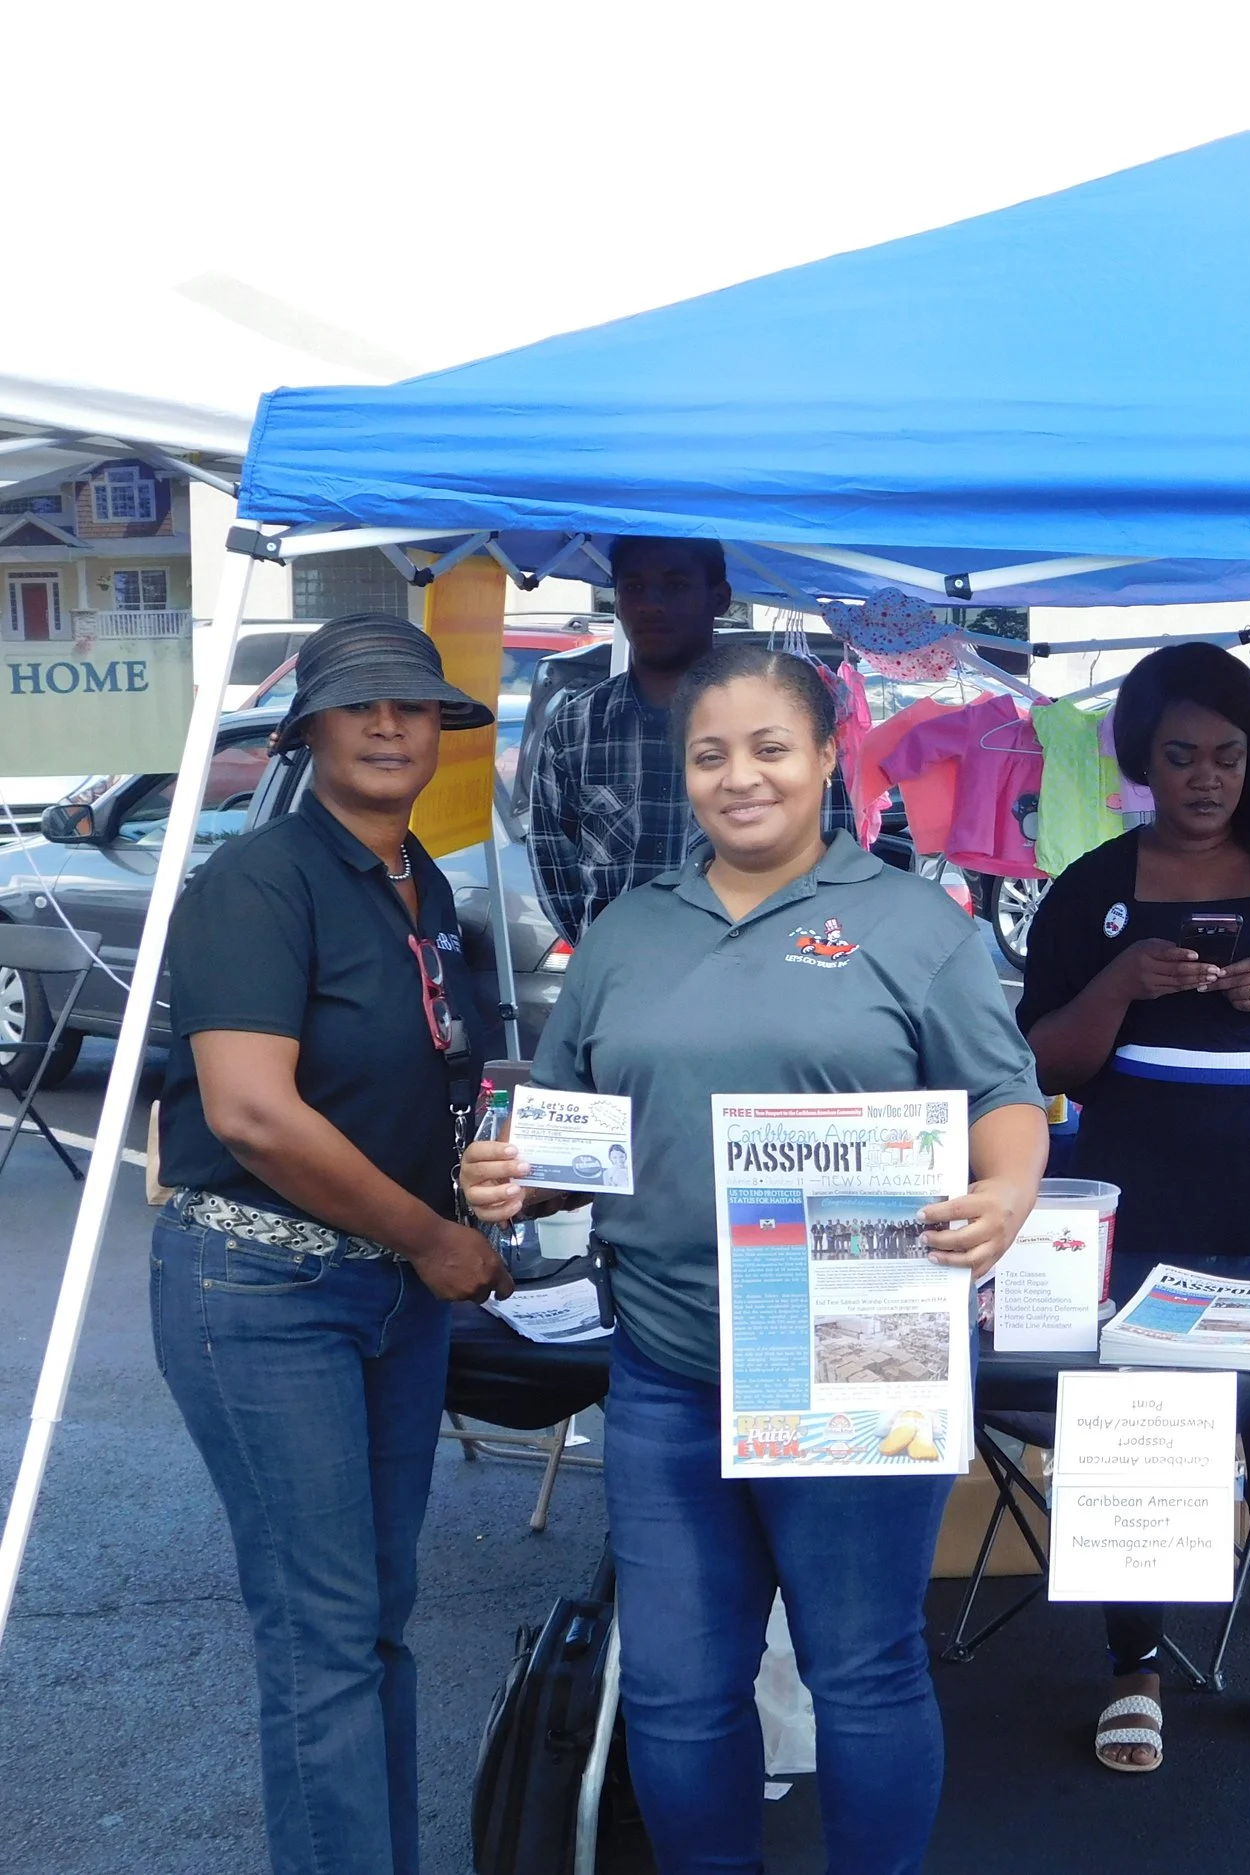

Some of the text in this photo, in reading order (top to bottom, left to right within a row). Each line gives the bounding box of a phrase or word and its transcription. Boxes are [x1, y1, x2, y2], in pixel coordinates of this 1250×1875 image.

[10, 659, 149, 695] HOME
[803, 957, 816, 965] GO
[541, 1101, 580, 1113] Let's Go
[723, 1108, 753, 1118] FREE
[867, 1104, 902, 1119] Nov/Dec
[904, 1104, 922, 1118] 2017
[548, 1110, 589, 1124] Taxes
[727, 1123, 911, 1144] Caribbean American
[727, 1141, 867, 1172] PASSPORT
[870, 1173, 944, 1187] MAGAZINE
[729, 1189, 738, 1197] US
[739, 1189, 749, 1197] TO
[750, 1189, 763, 1197] END
[764, 1189, 801, 1197] PROTECTED
[1023, 1288, 1052, 1296] Keeping
[1025, 1313, 1060, 1321] Qualifying
[1131, 1399, 1163, 1411] Point
[1077, 1417, 1215, 1430] Newsmagazine/Alpha
[1117, 1437, 1174, 1450] Passport
[1078, 1455, 1210, 1467] Caribbean American
[1077, 1494, 1209, 1508] Caribbean American
[1113, 1515, 1171, 1530] Passport
[1072, 1535, 1212, 1551] Newsmagazine/Alpha
[1124, 1557, 1157, 1569] Point
